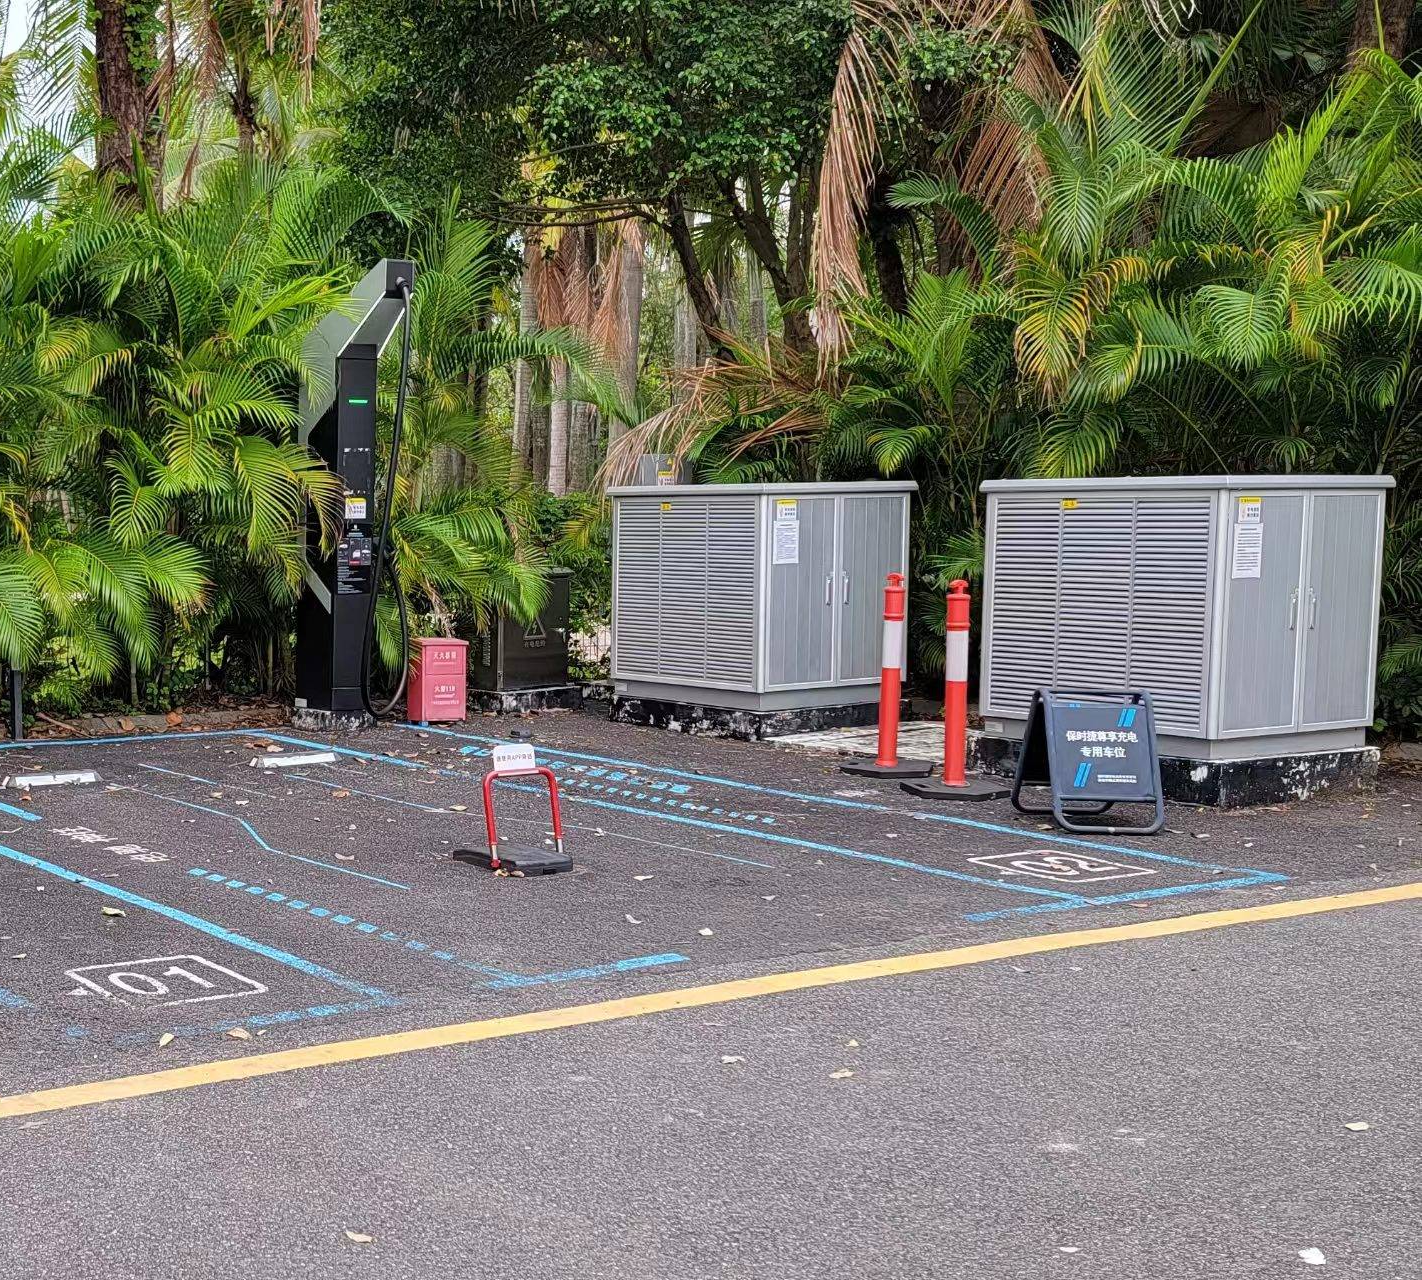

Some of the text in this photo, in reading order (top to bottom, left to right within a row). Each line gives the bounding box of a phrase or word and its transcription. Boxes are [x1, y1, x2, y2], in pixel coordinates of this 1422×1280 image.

[1066, 730, 1139, 743] 保时捷尊享充电
[1080, 746, 1127, 758] 专用车位
[1010, 855, 1122, 876] 02
[107, 965, 215, 995] 01
